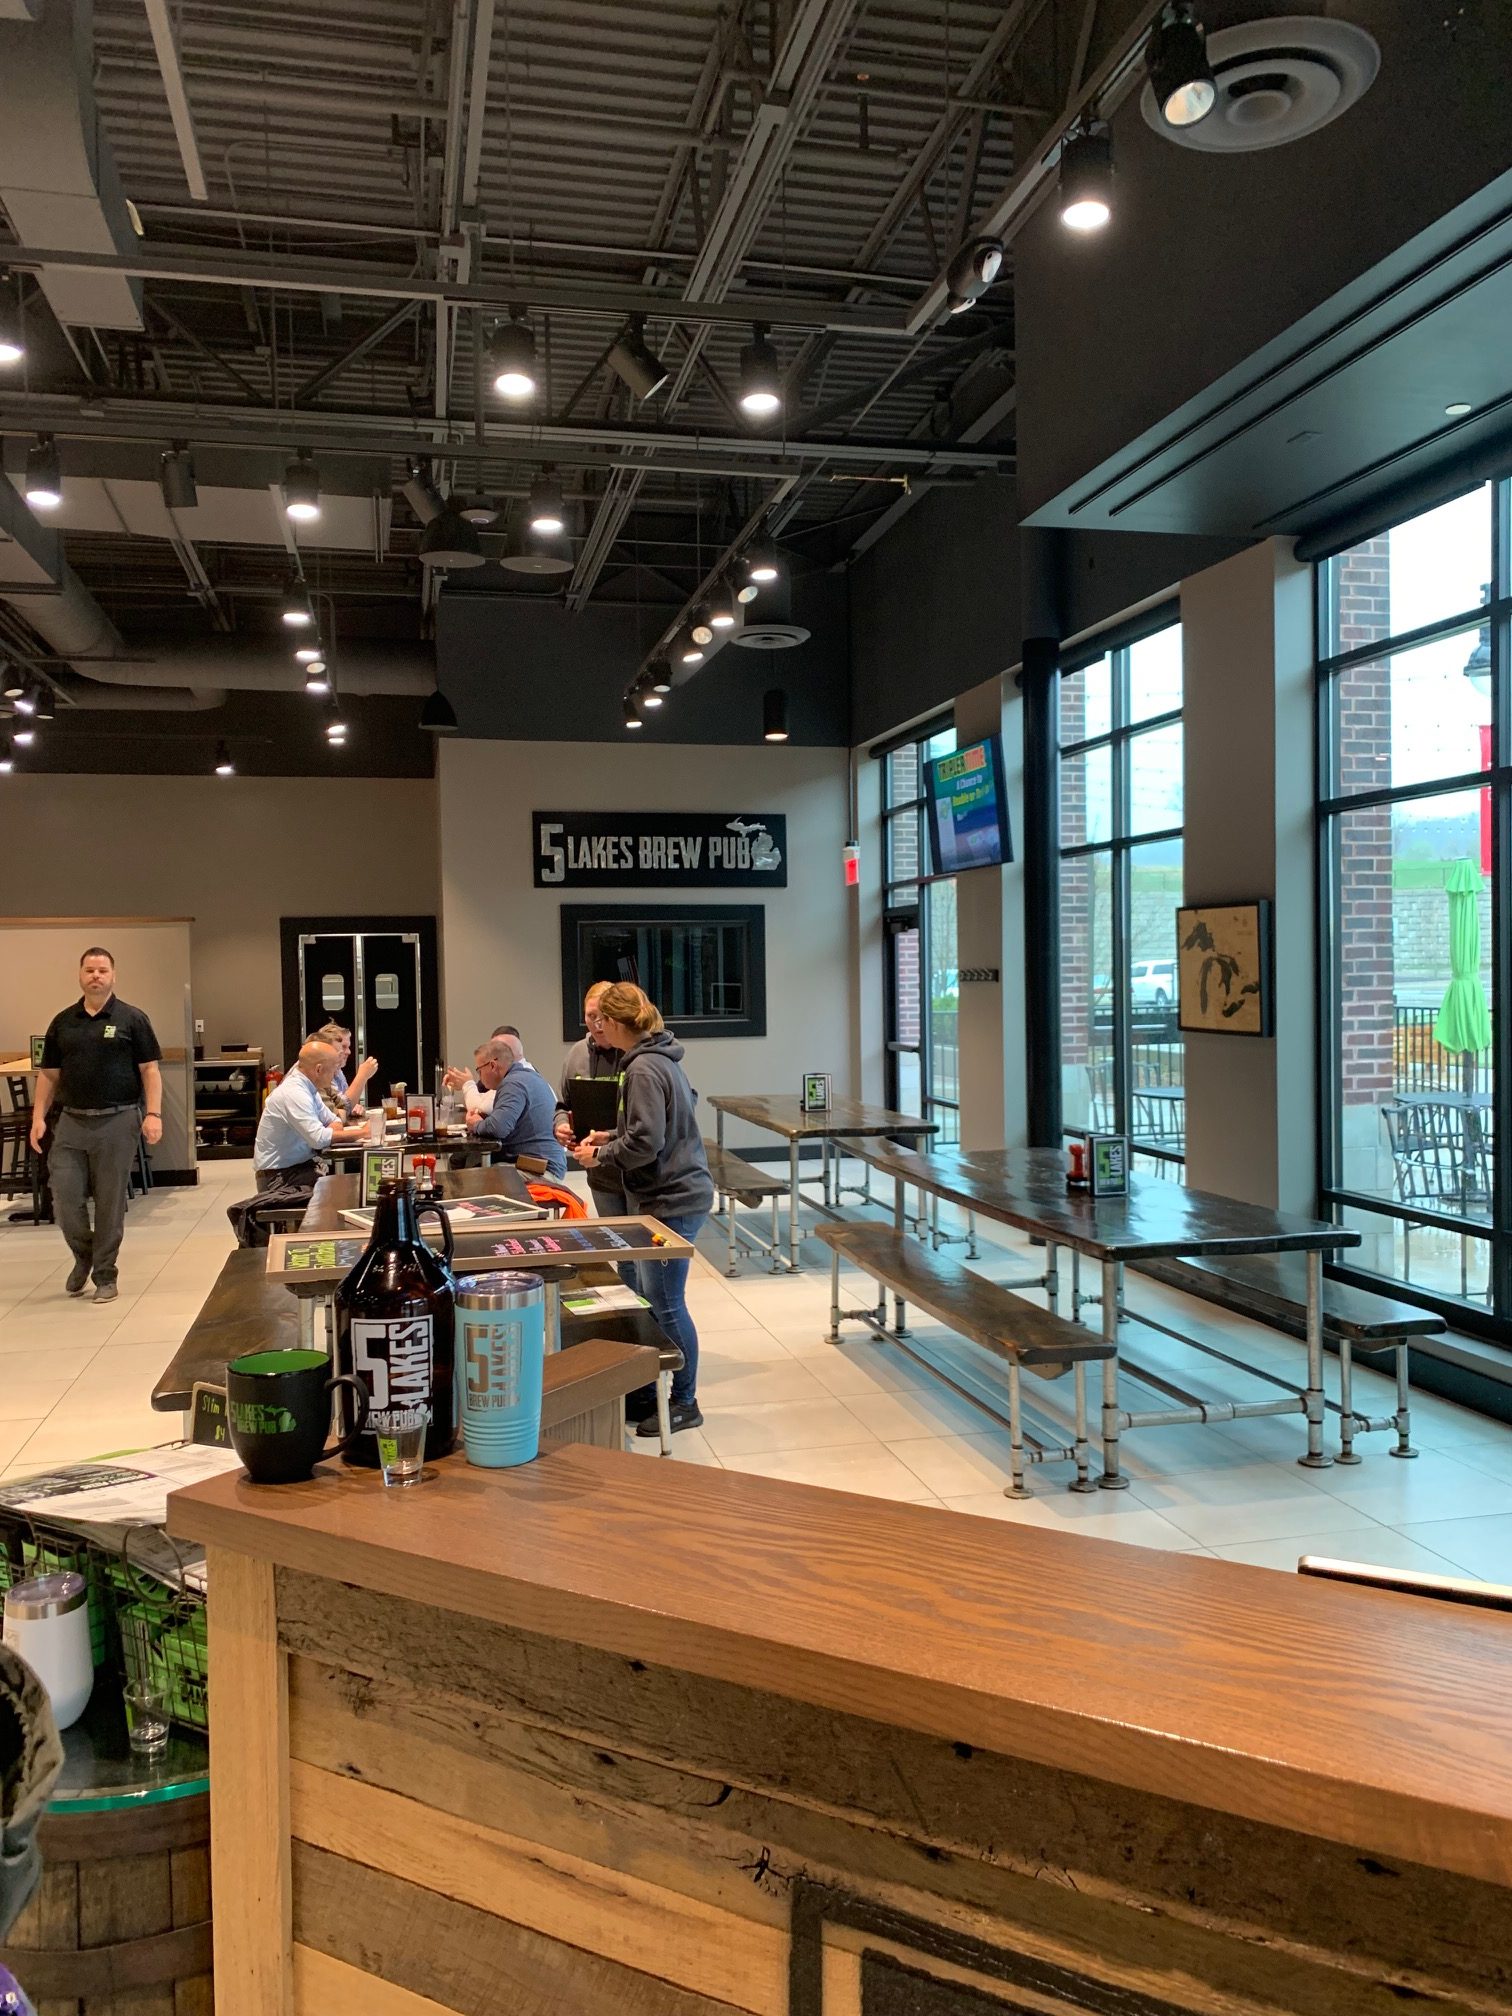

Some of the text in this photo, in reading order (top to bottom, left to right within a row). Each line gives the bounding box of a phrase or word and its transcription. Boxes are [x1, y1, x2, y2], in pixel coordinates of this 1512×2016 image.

[541, 824, 750, 882] 5 LAKES BREW PUB
[381, 1158, 396, 1179] KES
[355, 1320, 430, 1410] 5 LAKES
[467, 1326, 519, 1393] 5 LAKES
[469, 1394, 489, 1408] BREW
